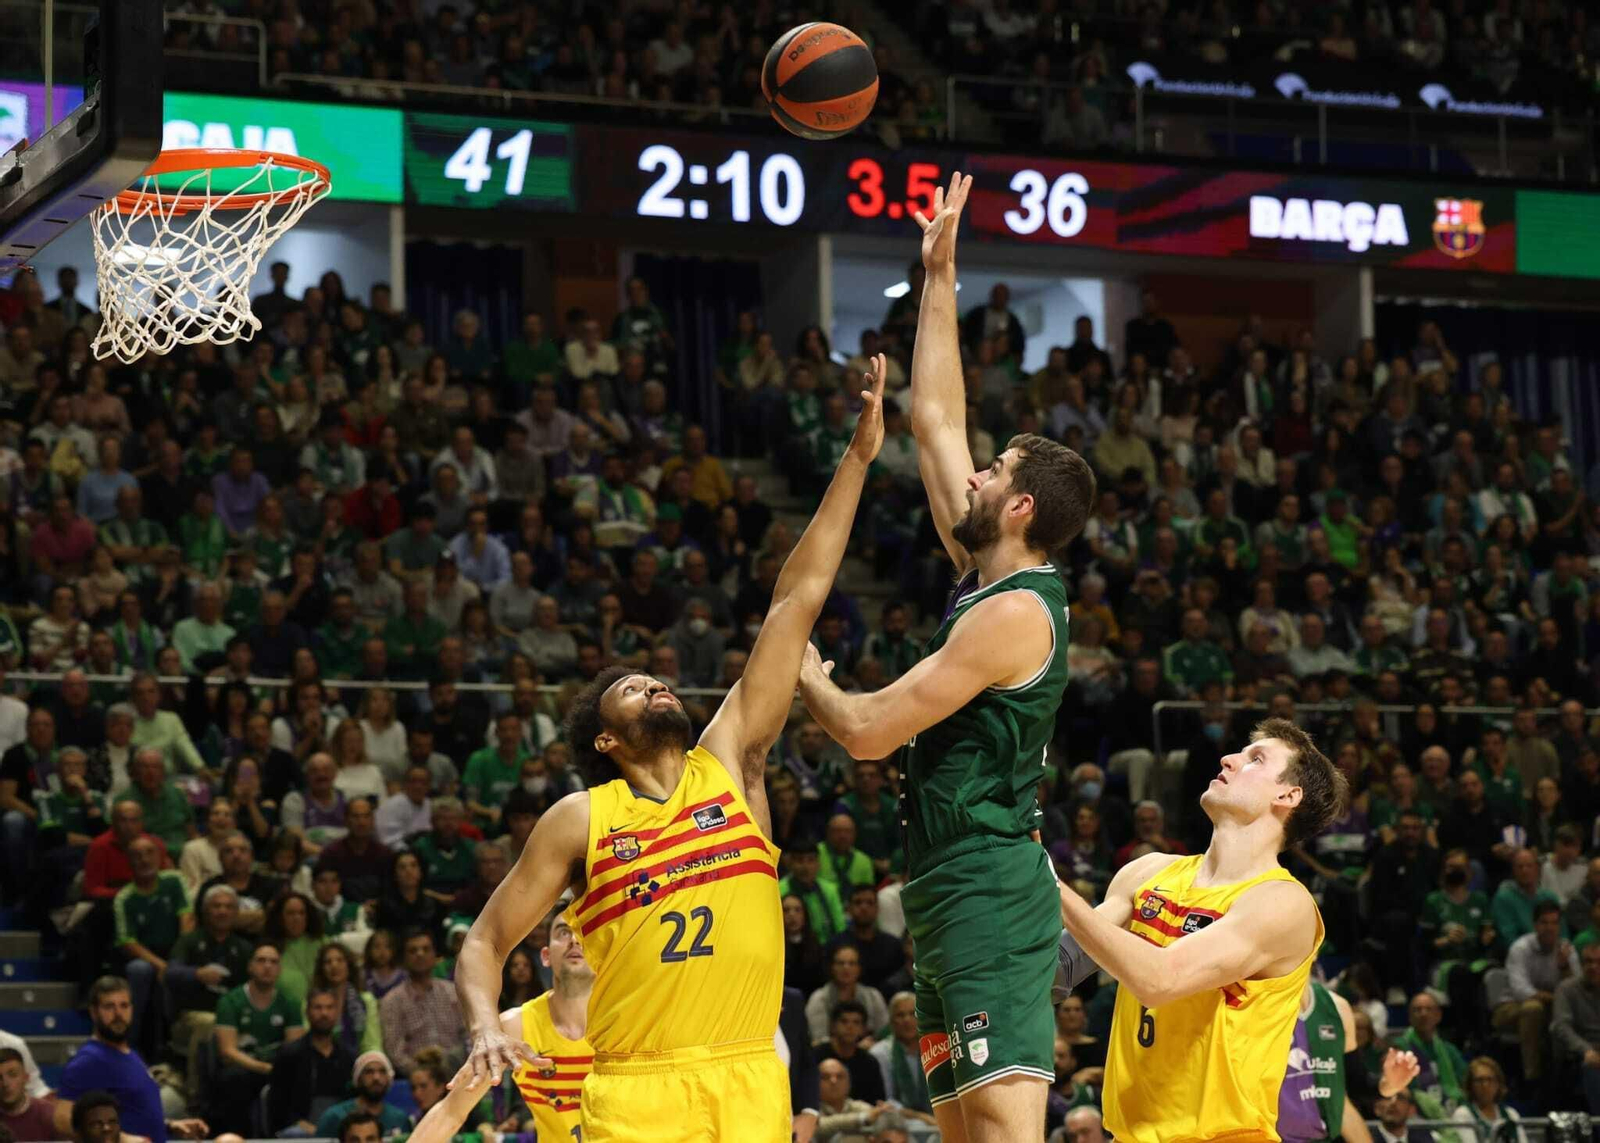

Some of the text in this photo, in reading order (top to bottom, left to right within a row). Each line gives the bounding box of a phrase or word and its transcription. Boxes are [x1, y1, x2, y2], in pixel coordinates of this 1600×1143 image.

[445, 127, 533, 195] 41
[637, 145, 805, 226] 2:10
[847, 158, 941, 220] 3.5
[1004, 169, 1090, 238] 36
[1249, 195, 1409, 252] BARÇA
[660, 905, 714, 963] 22
[965, 1019, 983, 1030] acb
